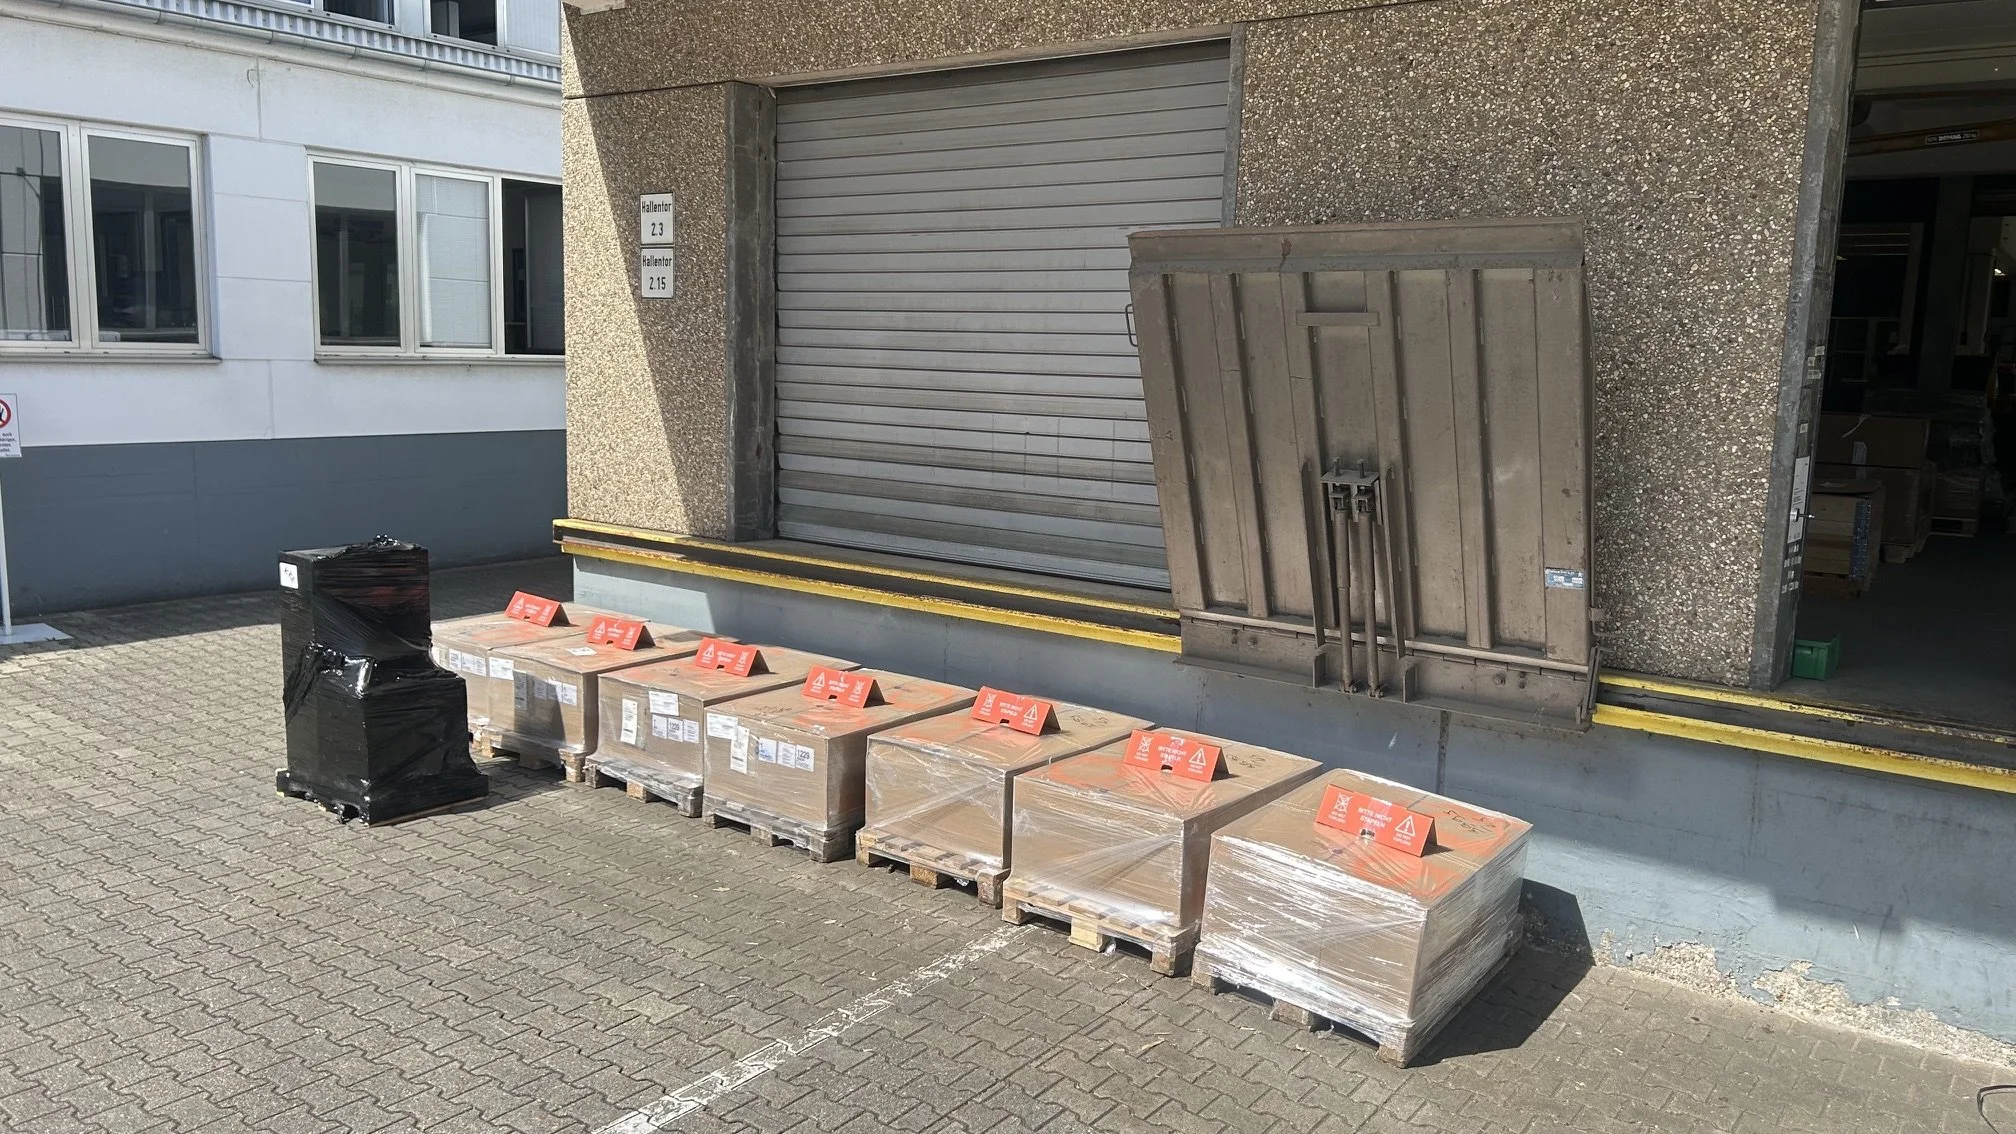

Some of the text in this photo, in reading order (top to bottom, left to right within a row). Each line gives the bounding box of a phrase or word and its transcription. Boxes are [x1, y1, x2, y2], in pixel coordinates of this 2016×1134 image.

[641, 200, 672, 213] Hallentor
[651, 222, 664, 236] 2.3
[642, 255, 672, 267] Hallentor
[649, 276, 666, 290] 2.15
[797, 749, 810, 760] 1229
[1358, 808, 1393, 823] BITTE NICHT
[1359, 816, 1386, 828] STAPELN
